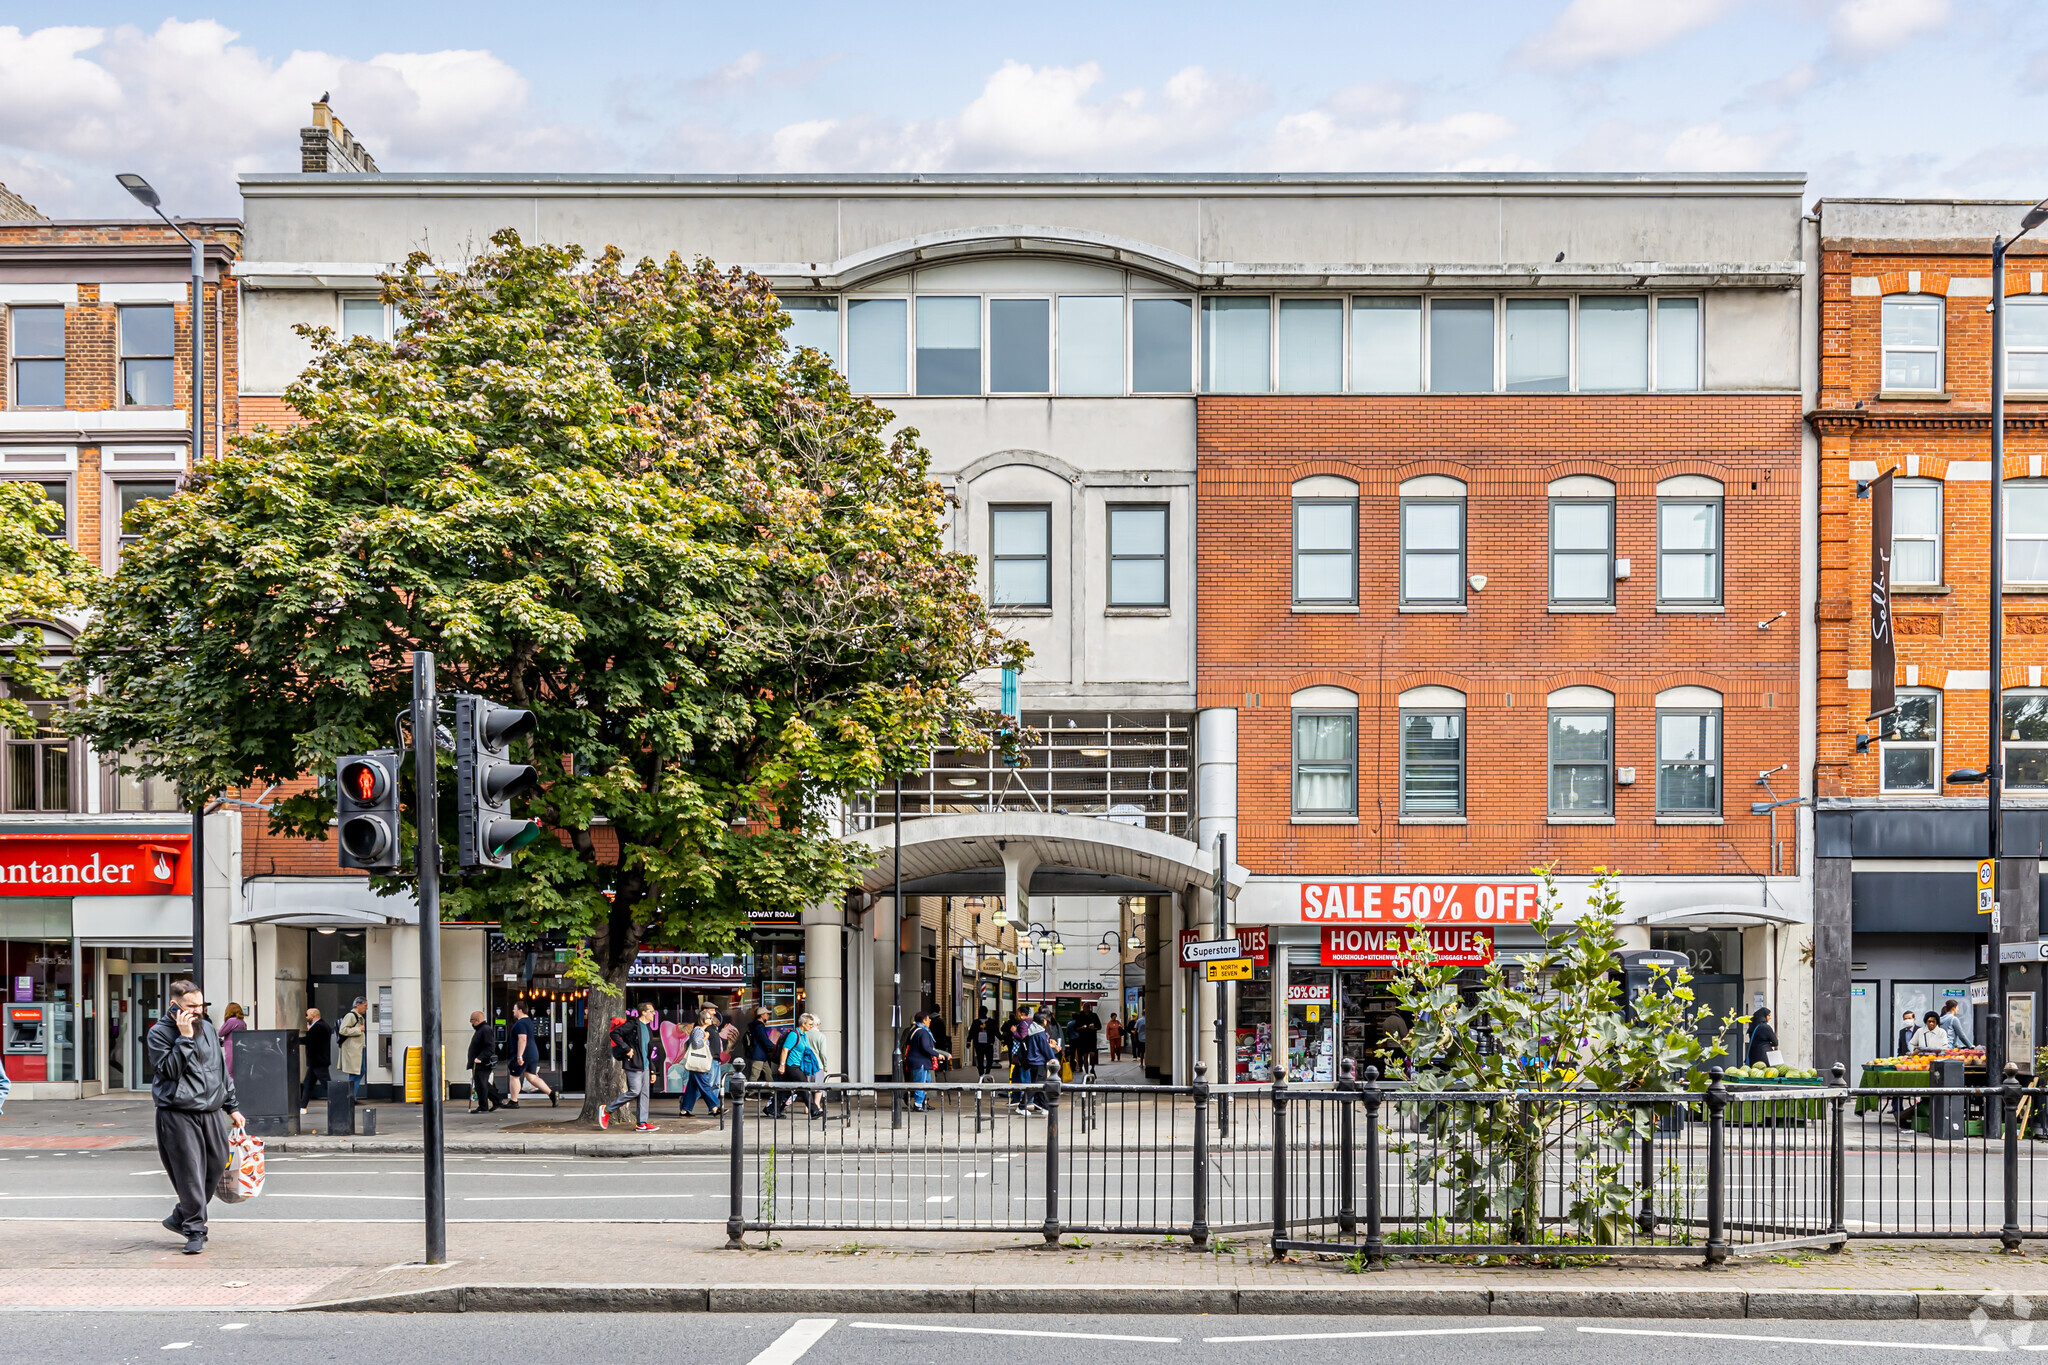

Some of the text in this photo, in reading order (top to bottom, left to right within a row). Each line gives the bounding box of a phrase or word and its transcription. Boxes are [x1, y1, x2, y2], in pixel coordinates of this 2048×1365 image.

[1982, 868, 1991, 878] 20
[1305, 885, 1535, 919] SALE 50% OFF
[1331, 930, 1397, 951] HOME
[1193, 946, 1237, 957] Superstore
[673, 964, 707, 975] Done
[1063, 980, 1105, 989] Morriso
[1288, 986, 1329, 998] 50% OFF
